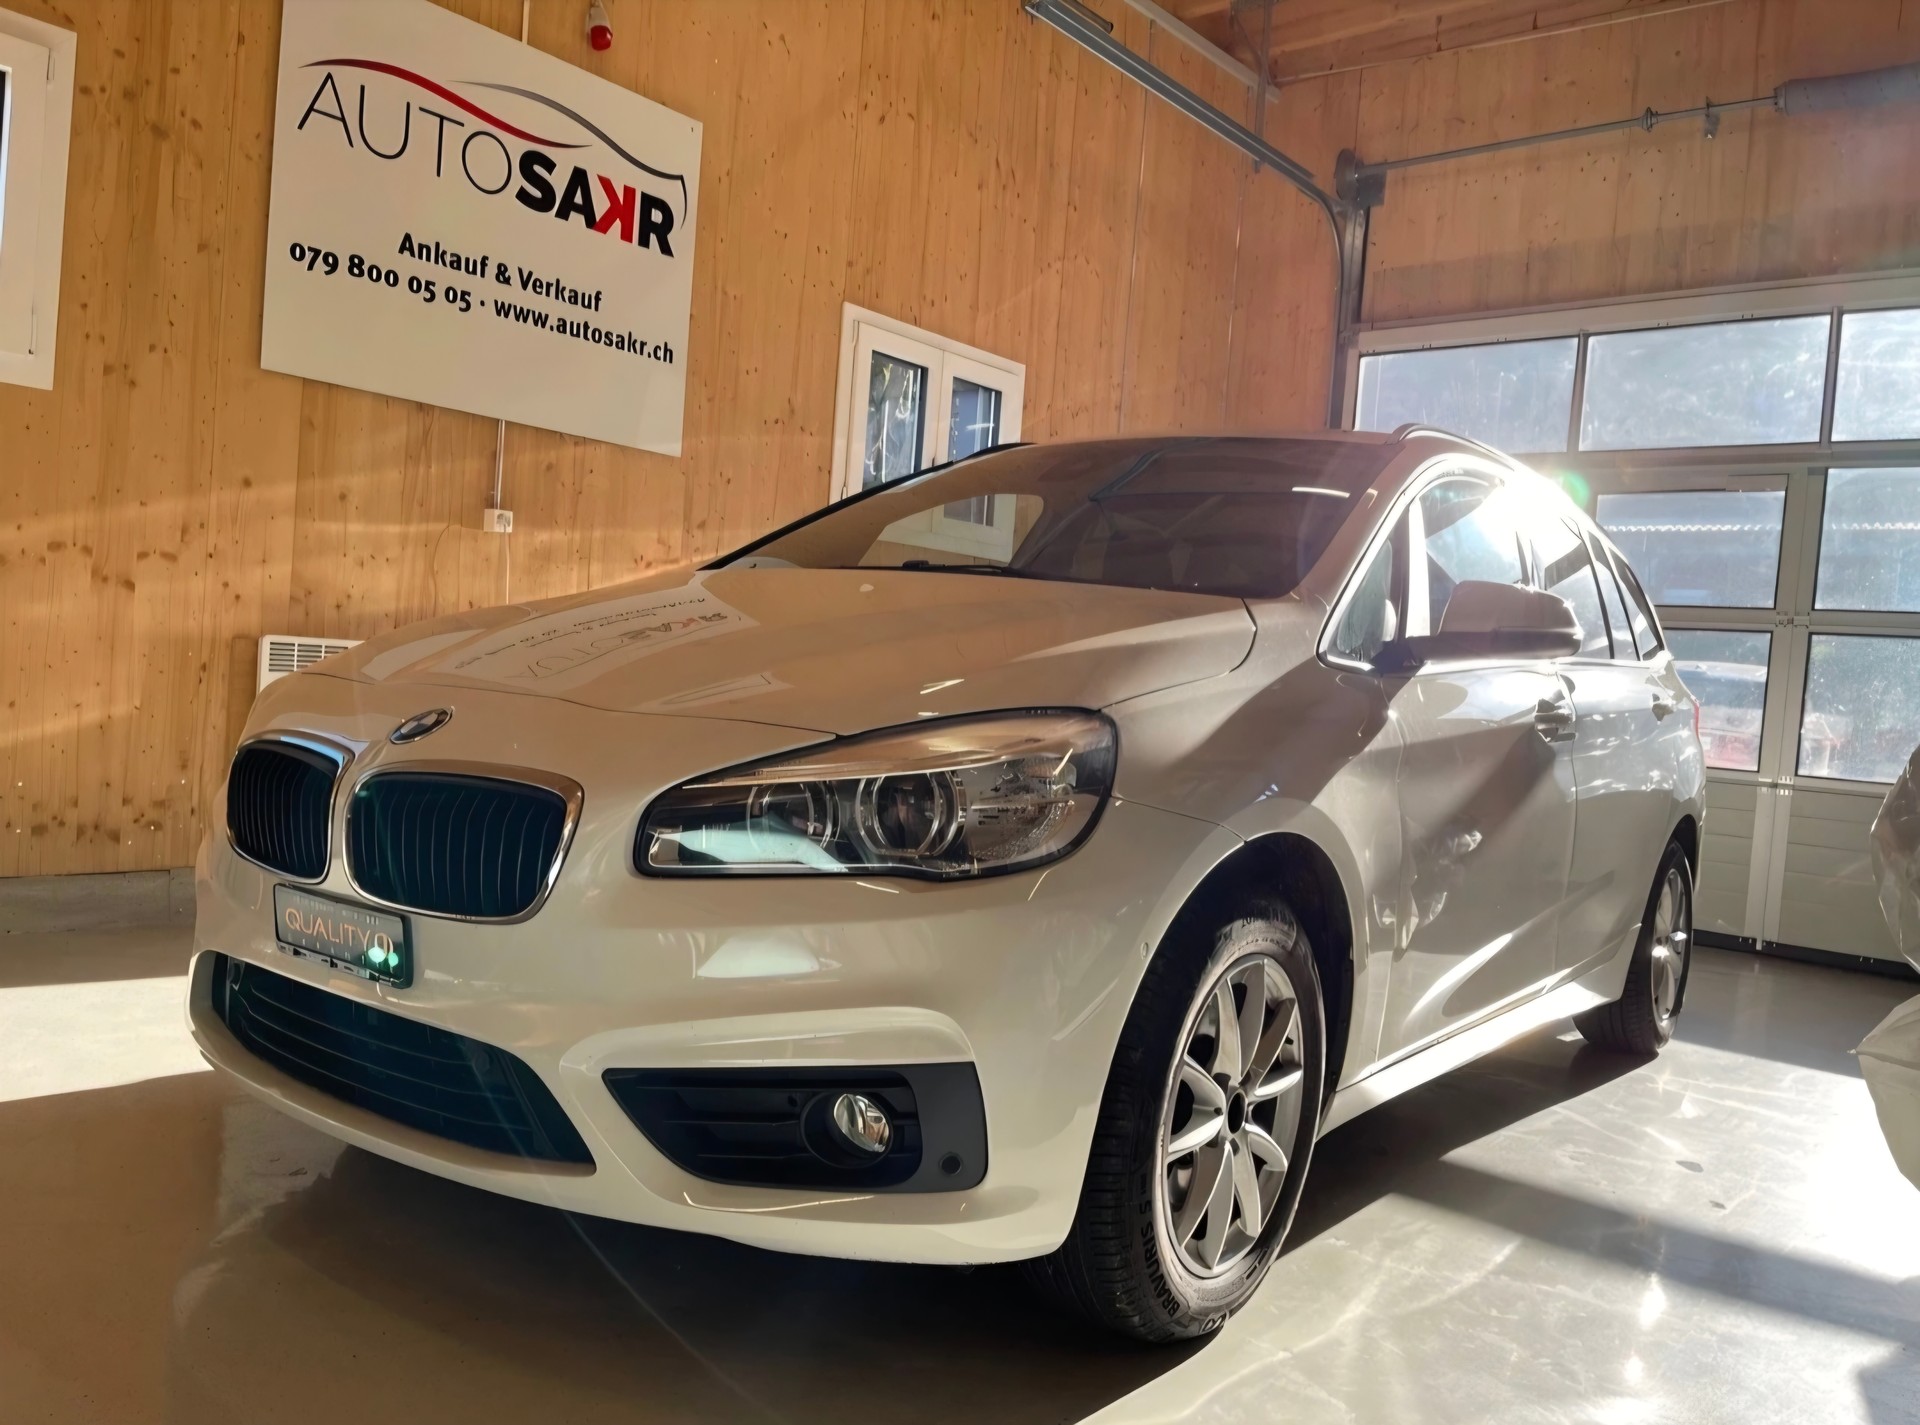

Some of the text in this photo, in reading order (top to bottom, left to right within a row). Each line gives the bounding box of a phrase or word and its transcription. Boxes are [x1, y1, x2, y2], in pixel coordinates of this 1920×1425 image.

[289, 242, 339, 276] 079
[347, 254, 399, 287] 800
[407, 275, 436, 303] 05
[444, 286, 472, 313] 05
[494, 299, 674, 364] www.autosakr.ch
[398, 232, 602, 312] Ankauf & Verkauf
[1140, 1221, 1180, 1318] BRAVURIS
